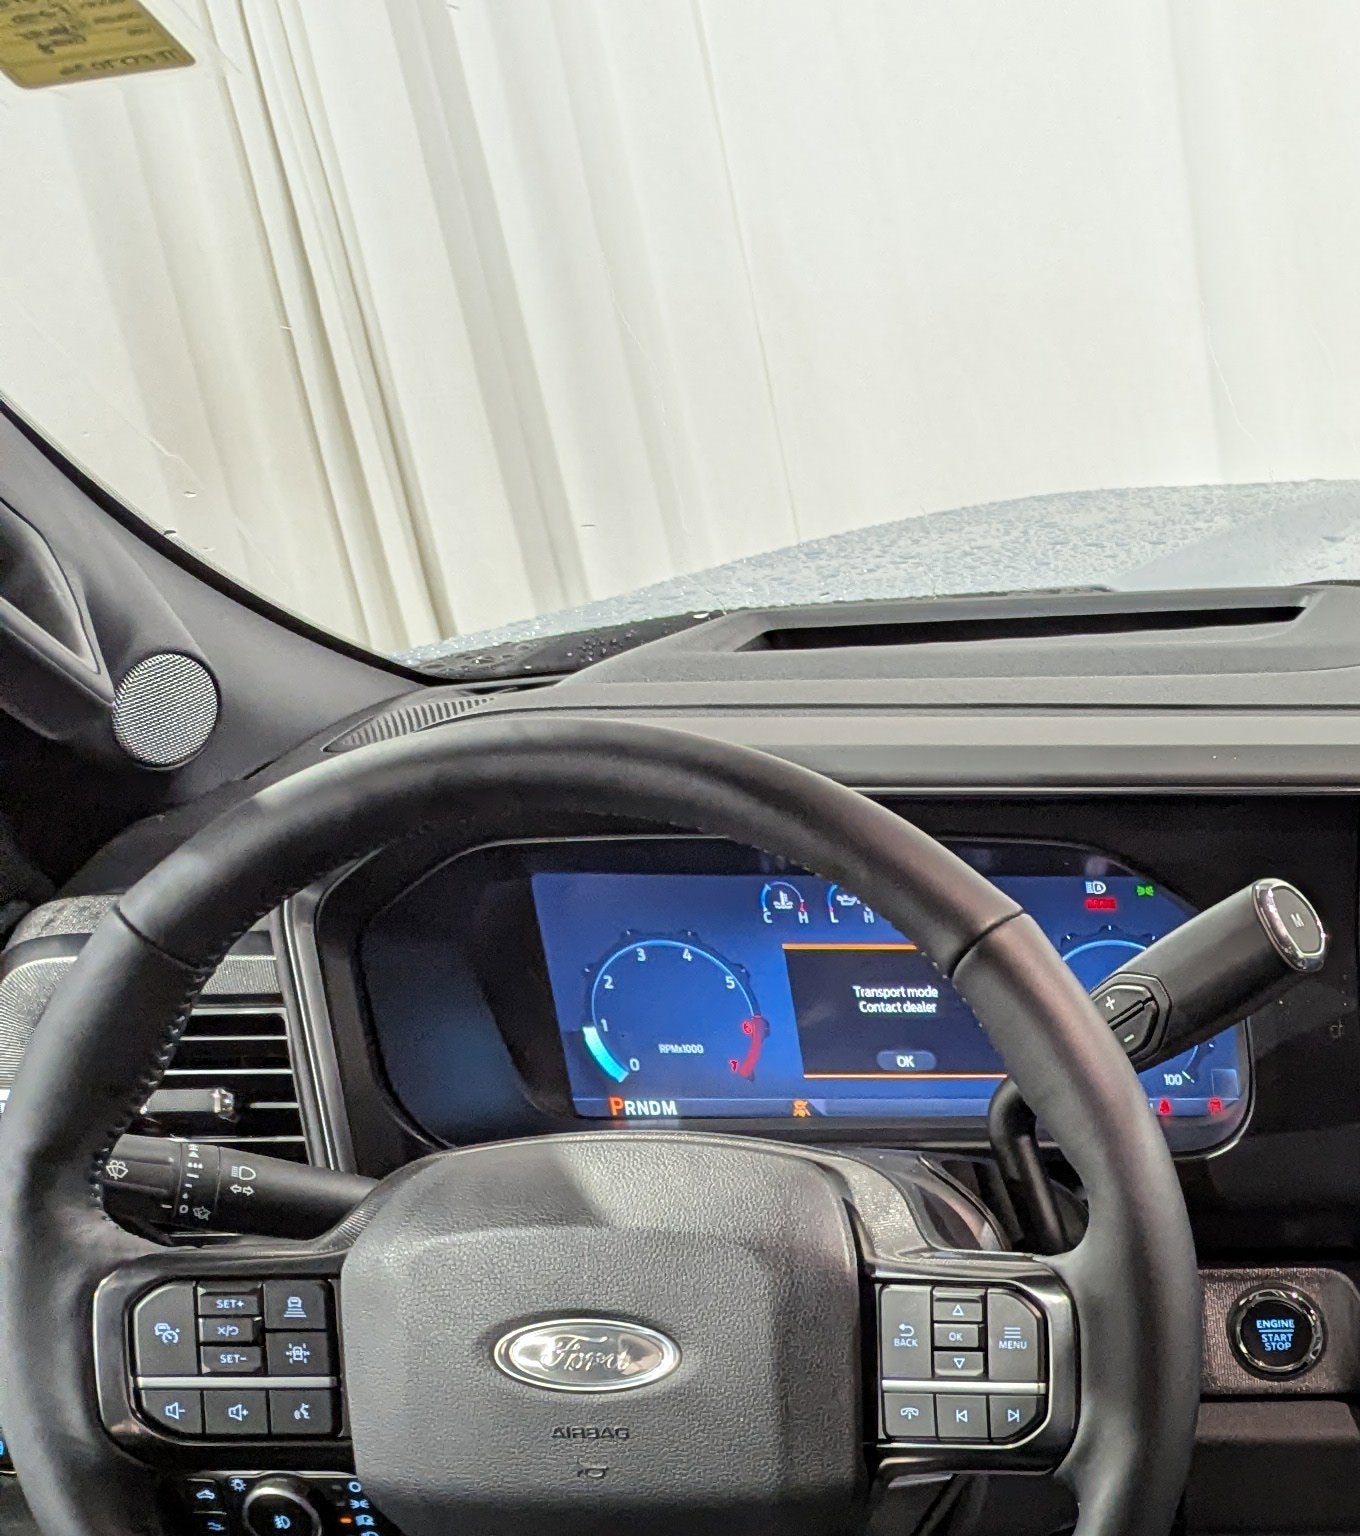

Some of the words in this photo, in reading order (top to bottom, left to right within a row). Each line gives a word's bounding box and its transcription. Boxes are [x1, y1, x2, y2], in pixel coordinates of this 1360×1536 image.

[763, 912, 773, 923] C
[799, 912, 809, 923] H
[830, 912, 839, 923] L
[864, 911, 874, 923] H
[636, 948, 646, 962] 3
[682, 948, 693, 962] 4
[603, 975, 614, 989] 2
[726, 976, 736, 989] 5
[852, 985, 906, 1000] Transport
[907, 985, 939, 998] mode
[859, 1001, 901, 1013] Contact
[902, 1001, 937, 1013] dealer
[601, 1019, 608, 1032] 1
[658, 1043, 704, 1054] RPMx1000
[630, 1058, 640, 1071] 0
[896, 1056, 915, 1068] OK
[1164, 1073, 1183, 1086] 100
[1256, 1319, 1295, 1329] ENGINE
[894, 1338, 918, 1347] BACK
[948, 1332, 963, 1341] OK
[1261, 1333, 1293, 1343] START
[998, 1341, 1027, 1349] MENU
[1264, 1342, 1291, 1351] STOP
[539, 1334, 631, 1372] Ford
[551, 1427, 630, 1440] AIRBAG
